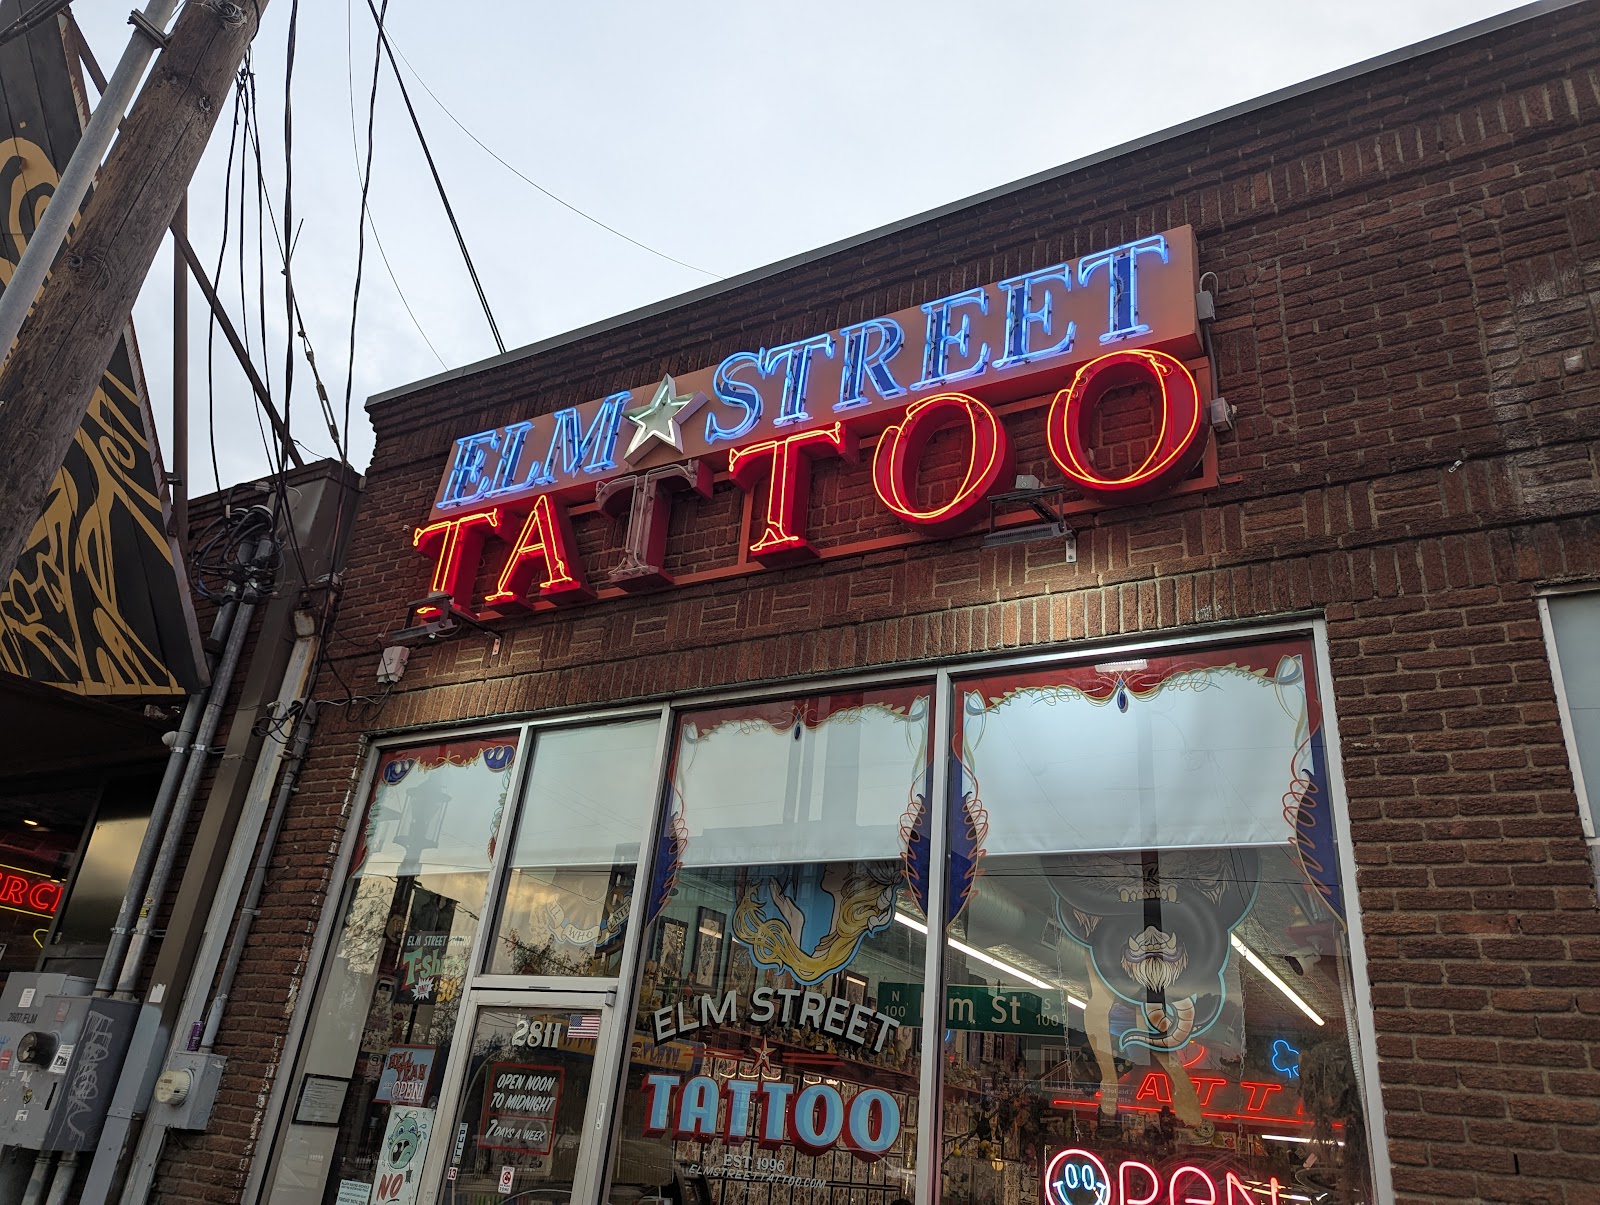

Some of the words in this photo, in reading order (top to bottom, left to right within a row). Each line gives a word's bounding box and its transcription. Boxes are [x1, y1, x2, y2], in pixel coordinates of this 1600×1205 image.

[436, 390, 634, 511] ELM
[703, 234, 1170, 446] STREET
[412, 348, 1212, 619] TATTOO
[407, 935, 422, 947] ELM
[423, 935, 448, 947] STREET
[891, 991, 900, 1002] N
[1043, 998, 1051, 1010] S
[654, 990, 738, 1046] ELM
[749, 987, 900, 1054] STREET
[884, 1005, 906, 1018] 100
[991, 996, 1021, 1025] St
[1035, 1014, 1059, 1027] 100
[511, 1021, 562, 1048] 2811
[391, 1081, 425, 1100] OPEN!
[497, 1073, 526, 1090] OPEN
[524, 1076, 556, 1092] NOON
[490, 1092, 505, 1109] TO
[504, 1093, 556, 1112] MIDNIGHT
[642, 1073, 901, 1162] TATTOO
[485, 1119, 498, 1139] 7
[494, 1126, 515, 1139] DAYS
[515, 1129, 523, 1140] A
[522, 1130, 547, 1142] WEEK
[455, 1129, 466, 1157] PULL
[448, 1168, 457, 1179] 13
[756, 1157, 785, 1173] 1996
[375, 1172, 403, 1202] NO
